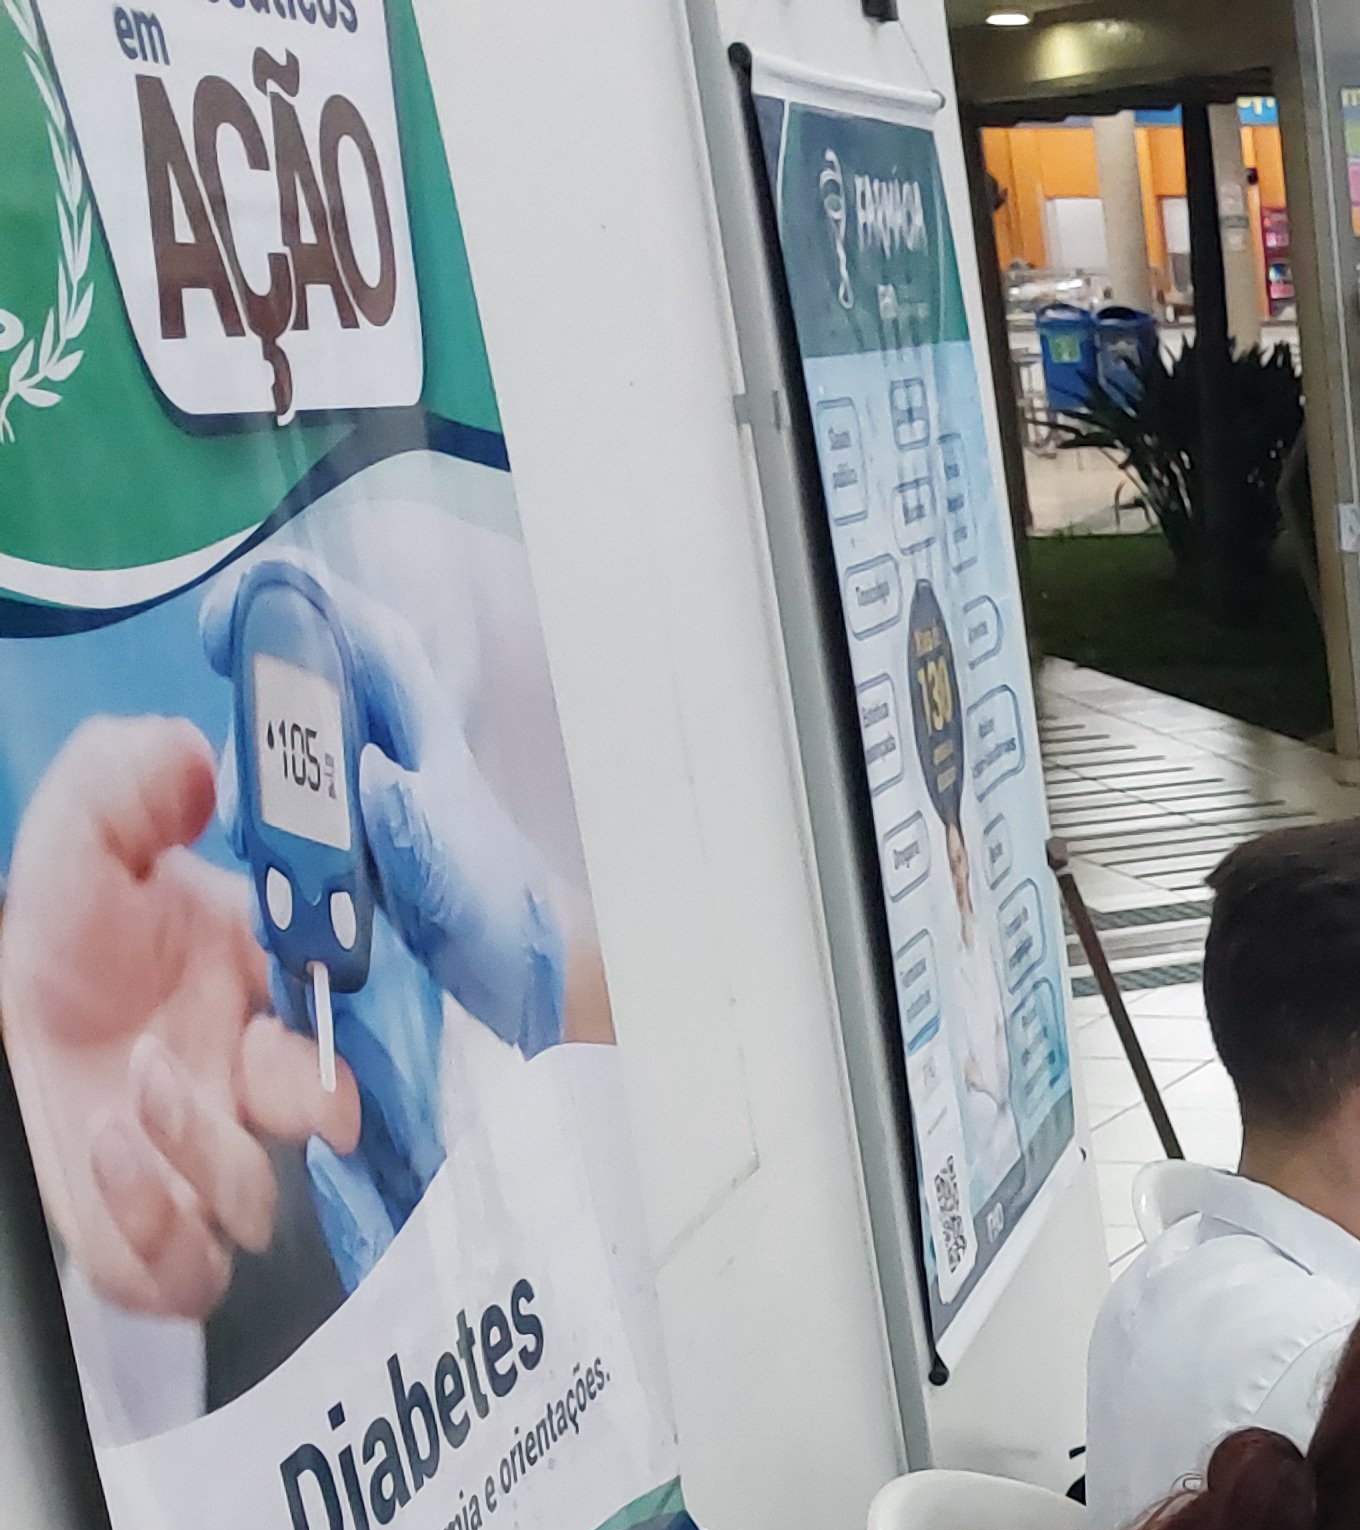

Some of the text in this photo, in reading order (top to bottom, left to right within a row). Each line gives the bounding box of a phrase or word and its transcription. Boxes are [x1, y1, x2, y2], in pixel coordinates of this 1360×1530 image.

[113, 6, 171, 65] em
[135, 46, 398, 417] AÇÃO
[279, 719, 321, 792] 105
[485, 1475, 498, 1514] e
[499, 1357, 611, 1494] orientações.
